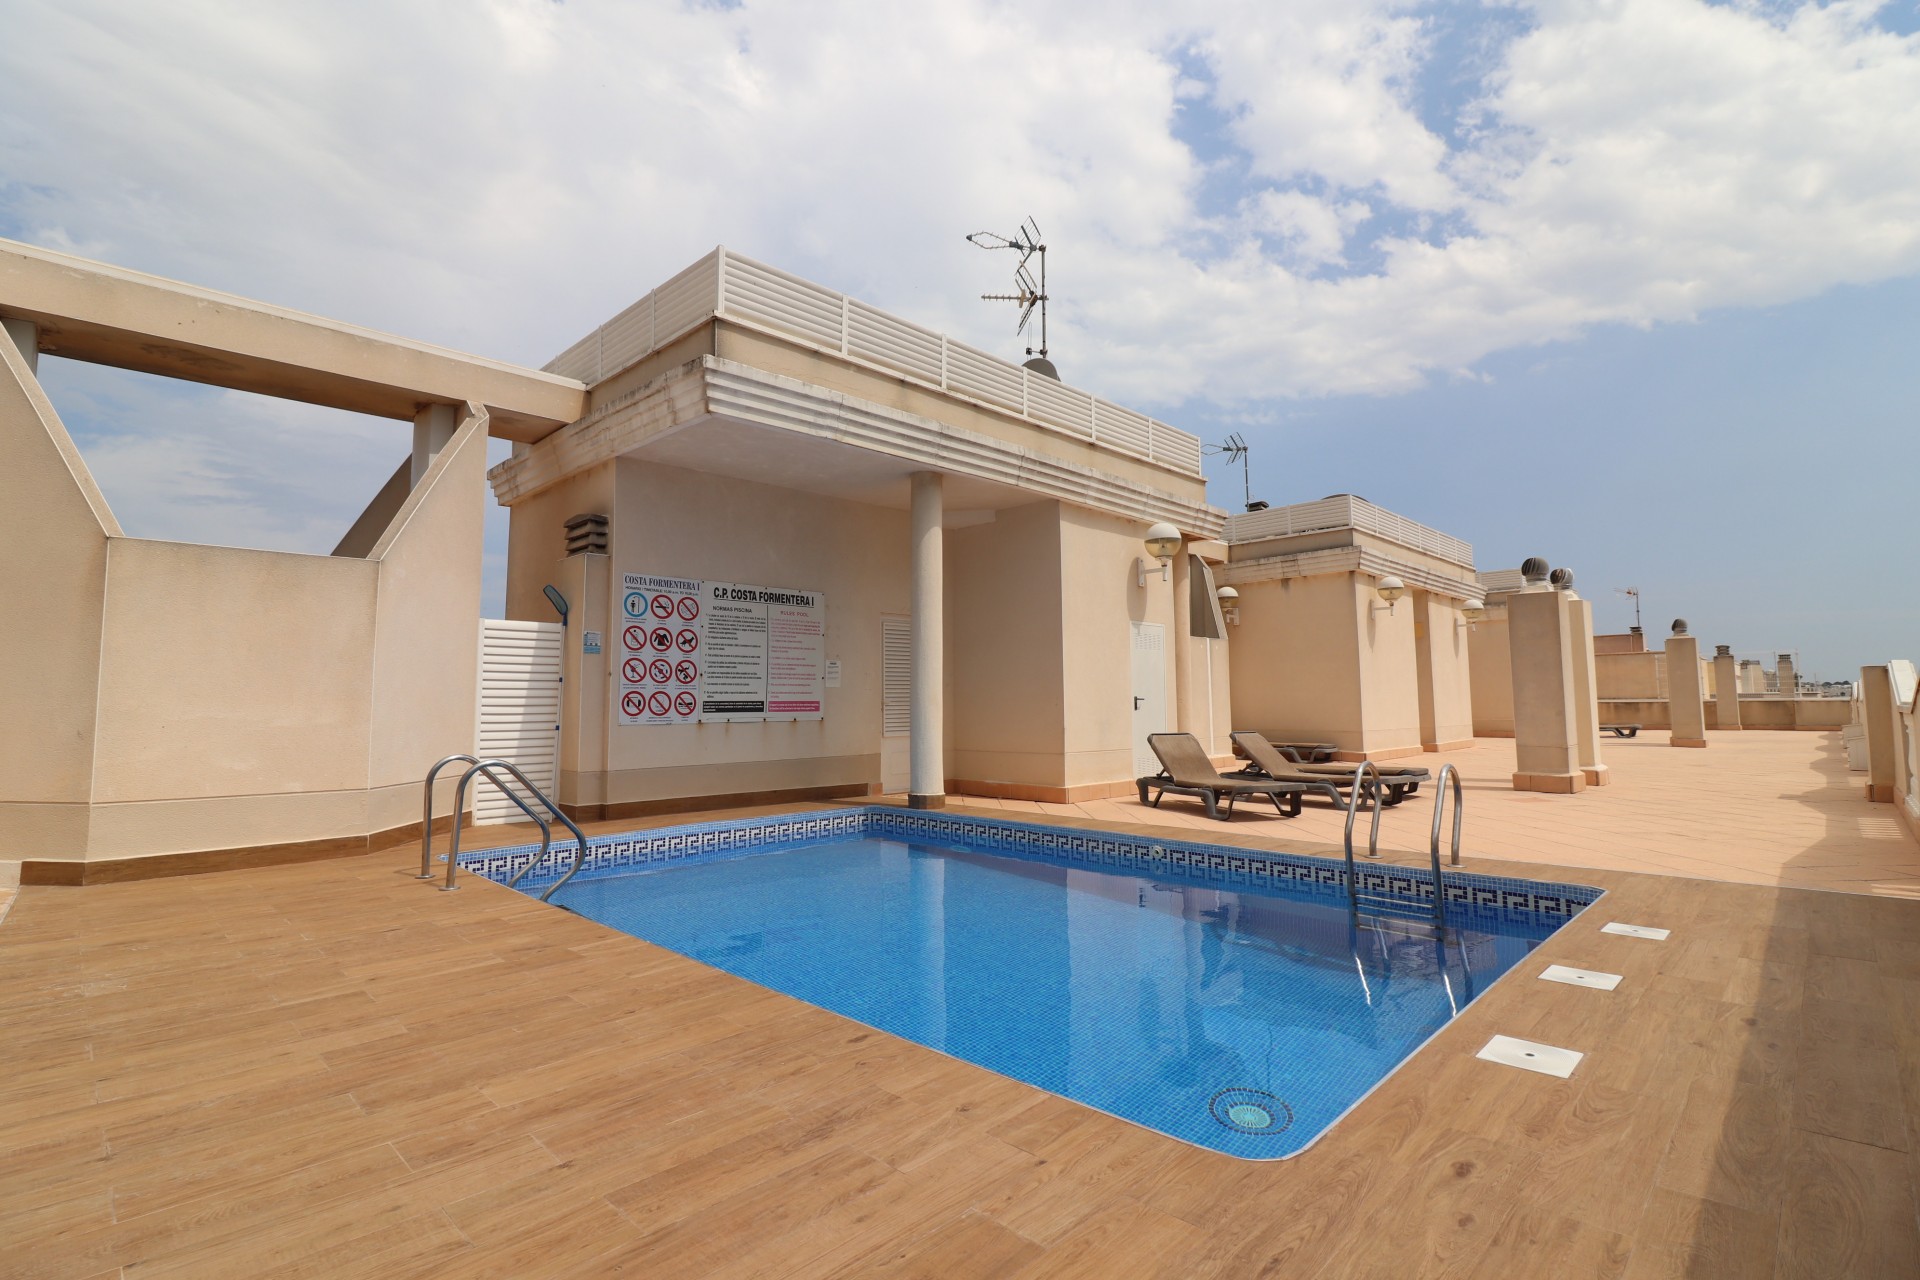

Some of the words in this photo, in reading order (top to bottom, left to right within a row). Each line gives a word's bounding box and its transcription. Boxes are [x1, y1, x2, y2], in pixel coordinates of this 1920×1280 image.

[624, 575, 647, 586] COSTA
[649, 578, 696, 590] FORMENTERA
[713, 587, 728, 599] C.P.
[730, 589, 757, 602] COSTA
[759, 591, 811, 606] FORMENTERA
